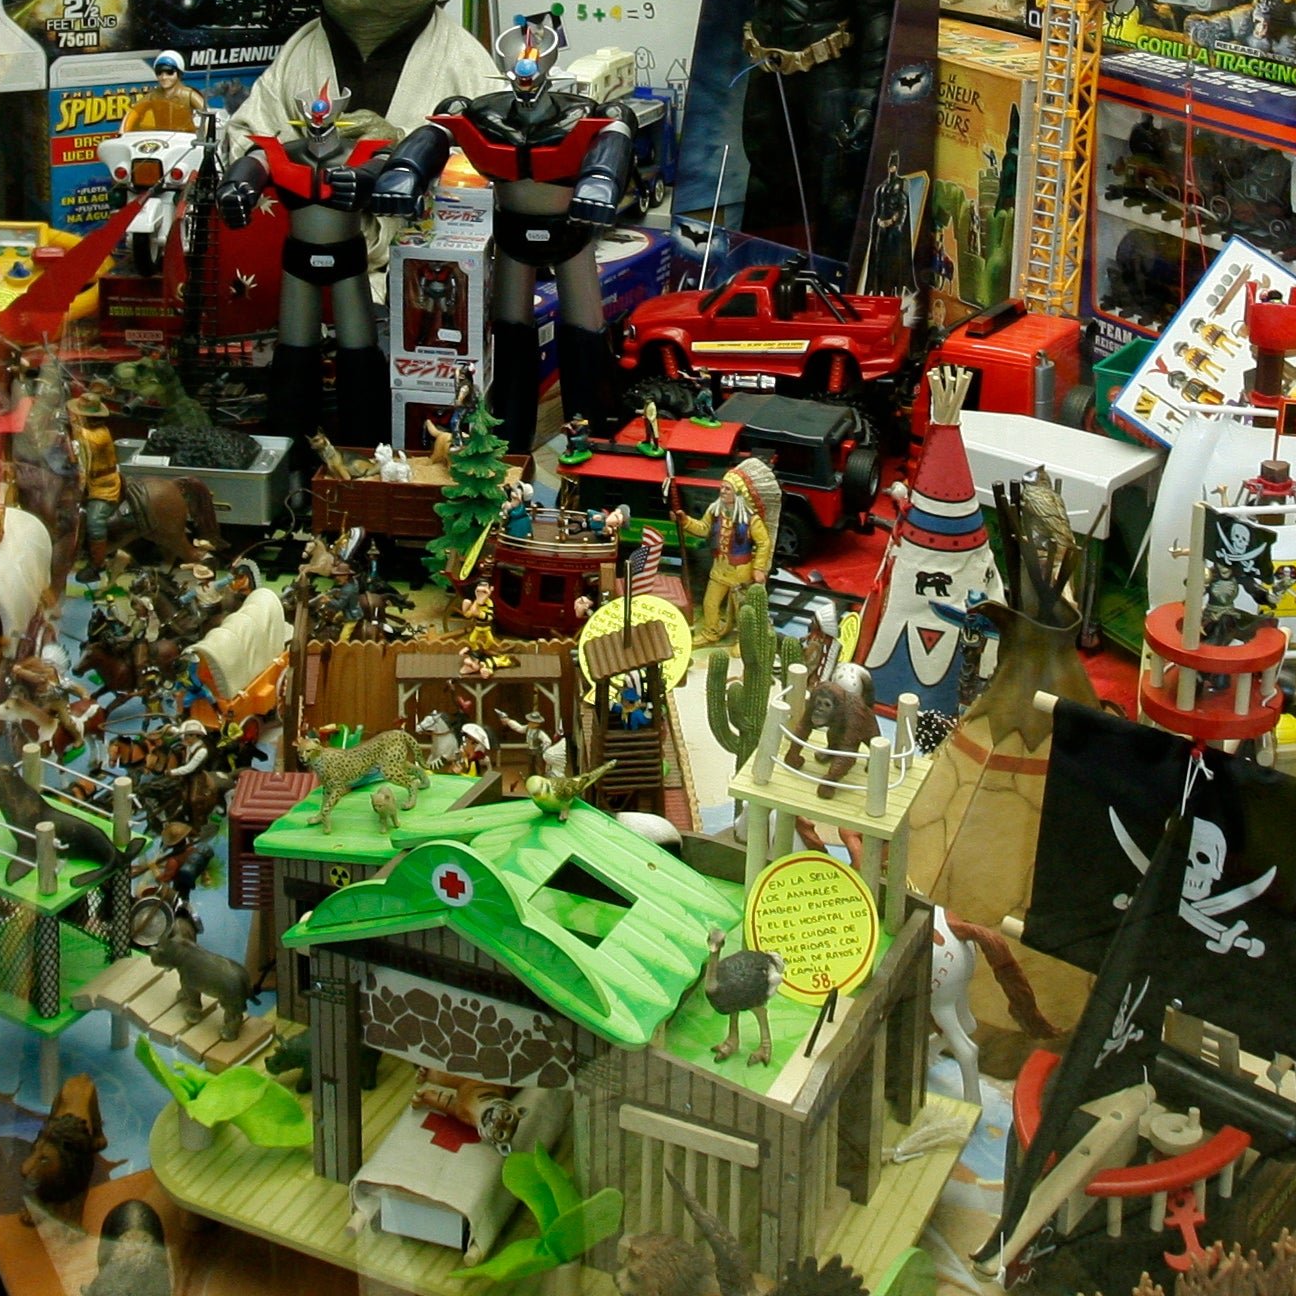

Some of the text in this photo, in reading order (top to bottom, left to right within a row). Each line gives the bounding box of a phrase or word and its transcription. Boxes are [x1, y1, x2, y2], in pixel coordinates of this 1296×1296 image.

[577, 4, 587, 21] 5
[642, 2, 655, 19] 9
[46, 17, 117, 31] FEET LONG
[58, 31, 98, 48] 75cm
[1137, 35, 1210, 64] GORILLA
[62, 150, 95, 162] WEB
